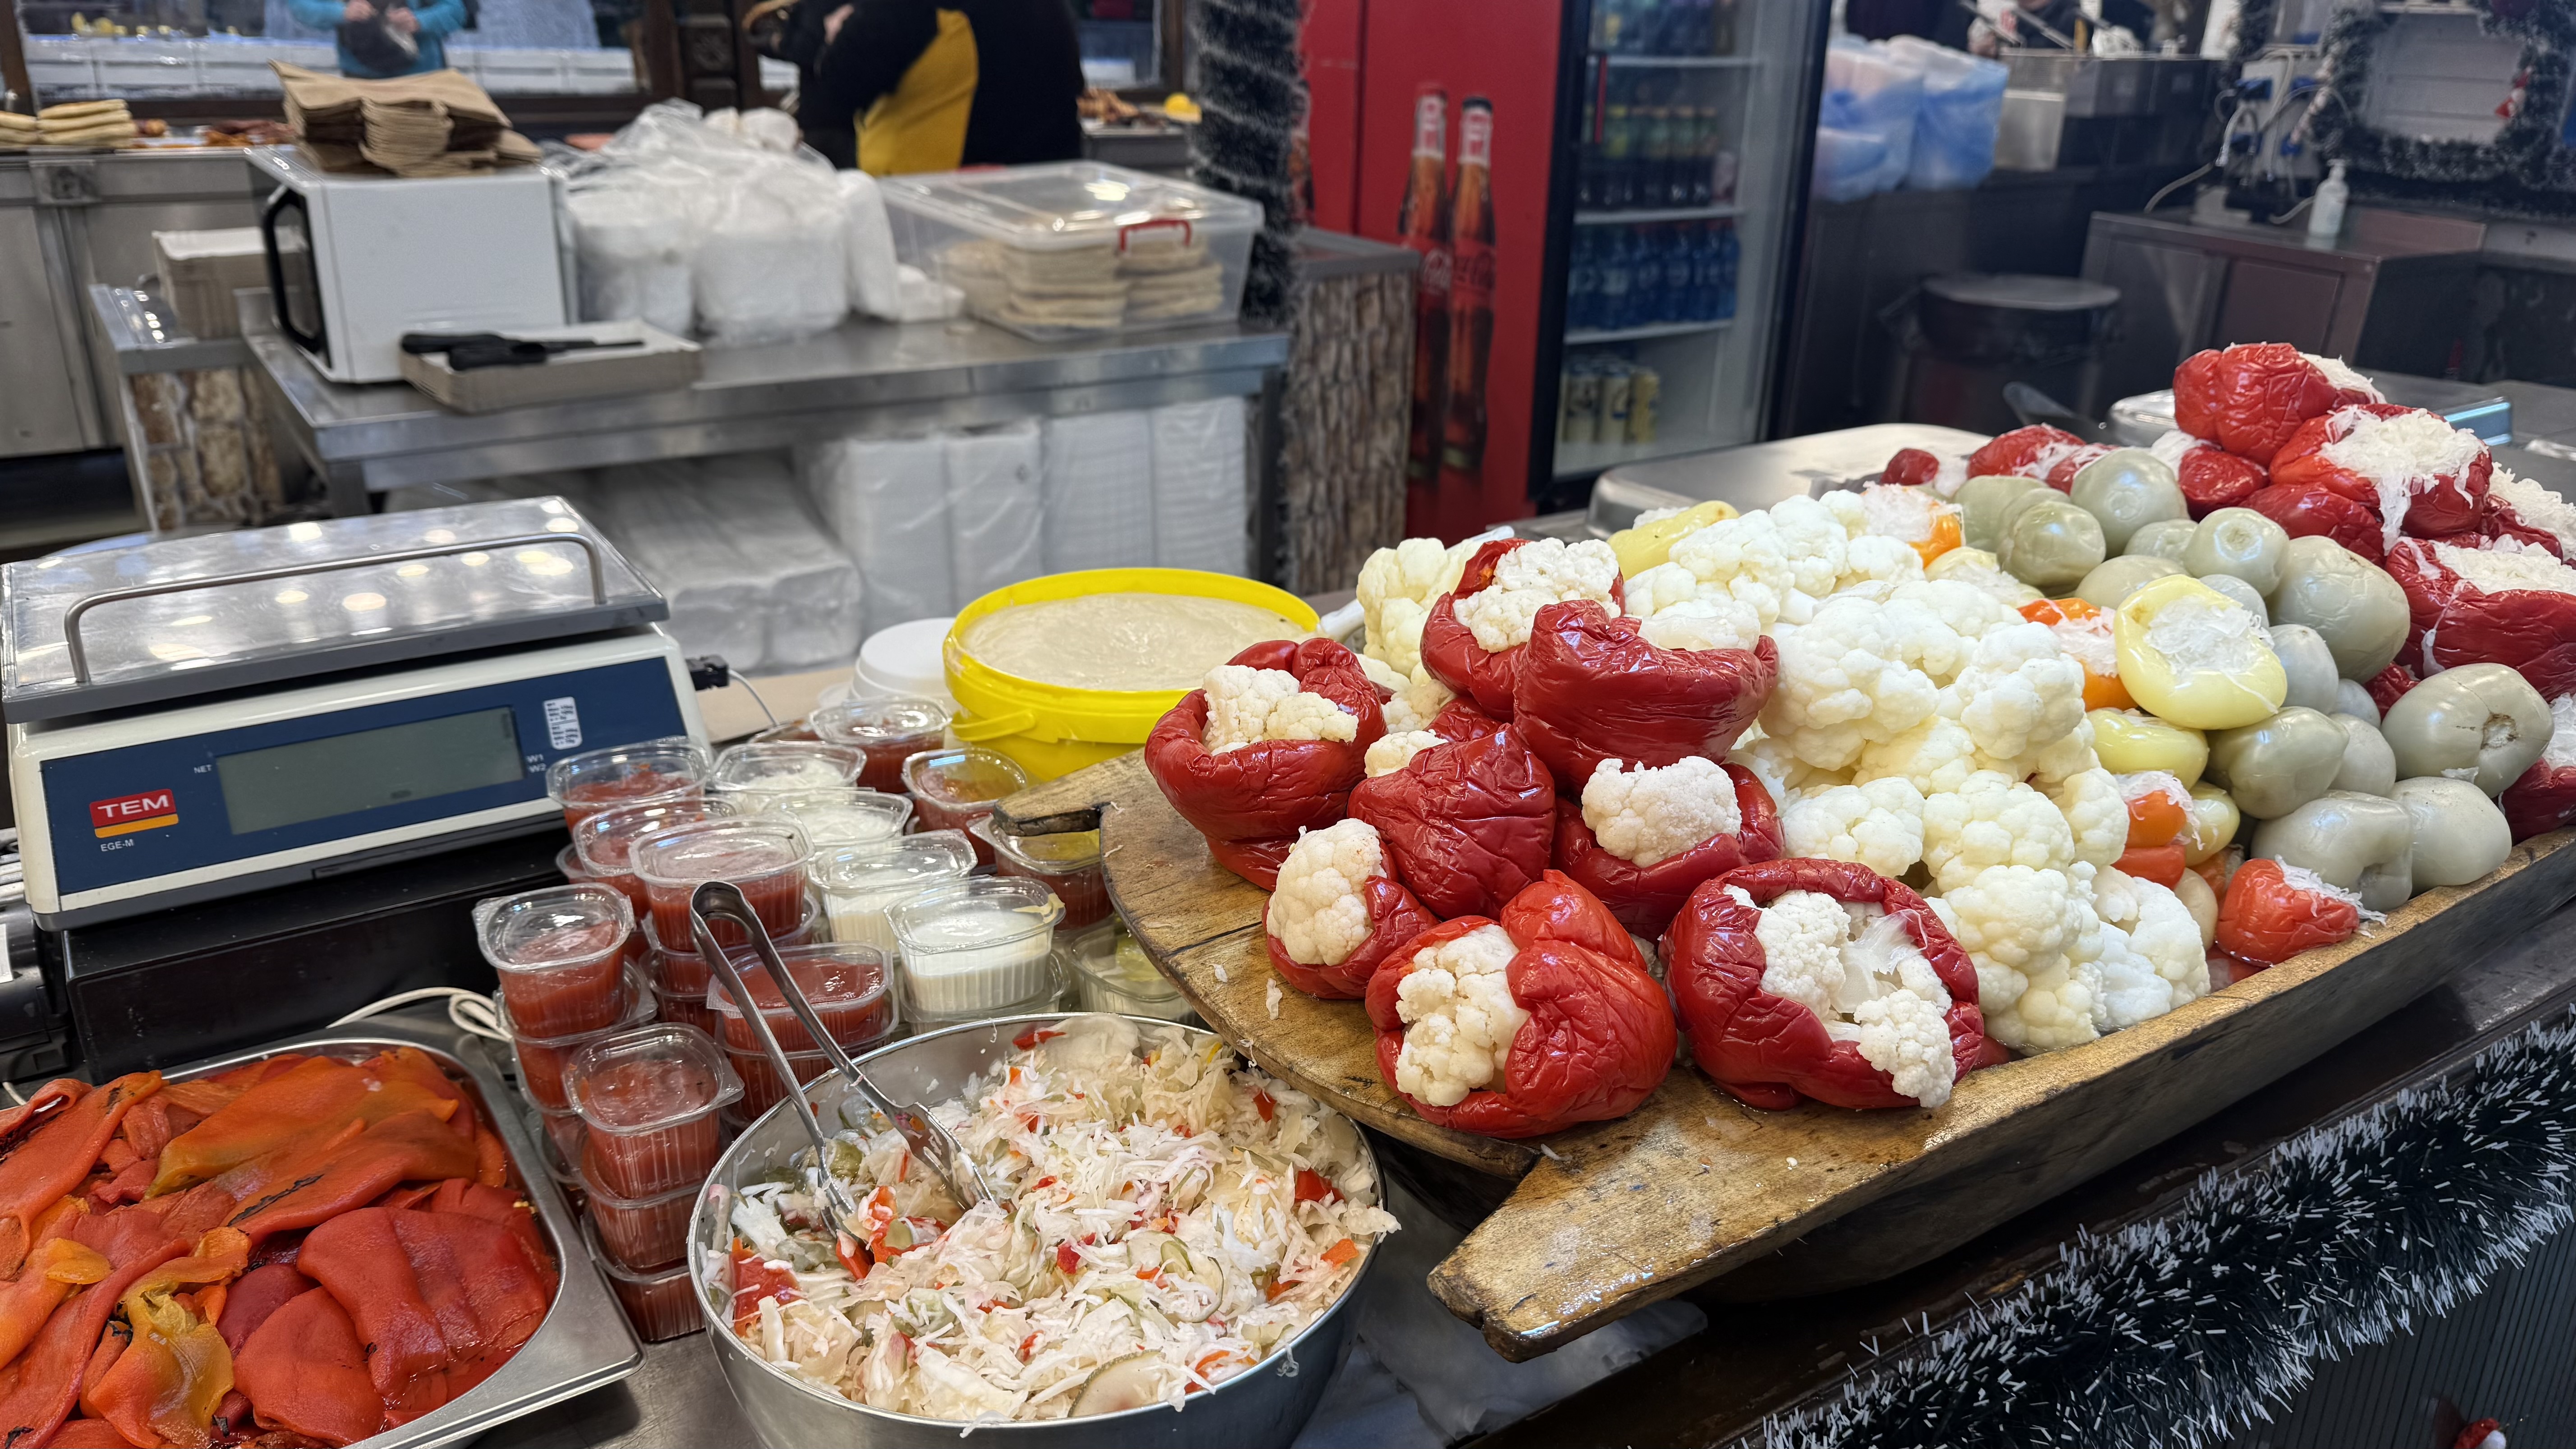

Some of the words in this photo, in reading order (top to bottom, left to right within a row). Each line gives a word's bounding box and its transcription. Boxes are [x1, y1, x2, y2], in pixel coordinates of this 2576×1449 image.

[527, 754, 543, 762] W1
[194, 764, 212, 773] NET
[529, 763, 546, 773] W2
[97, 795, 169, 818] TEM
